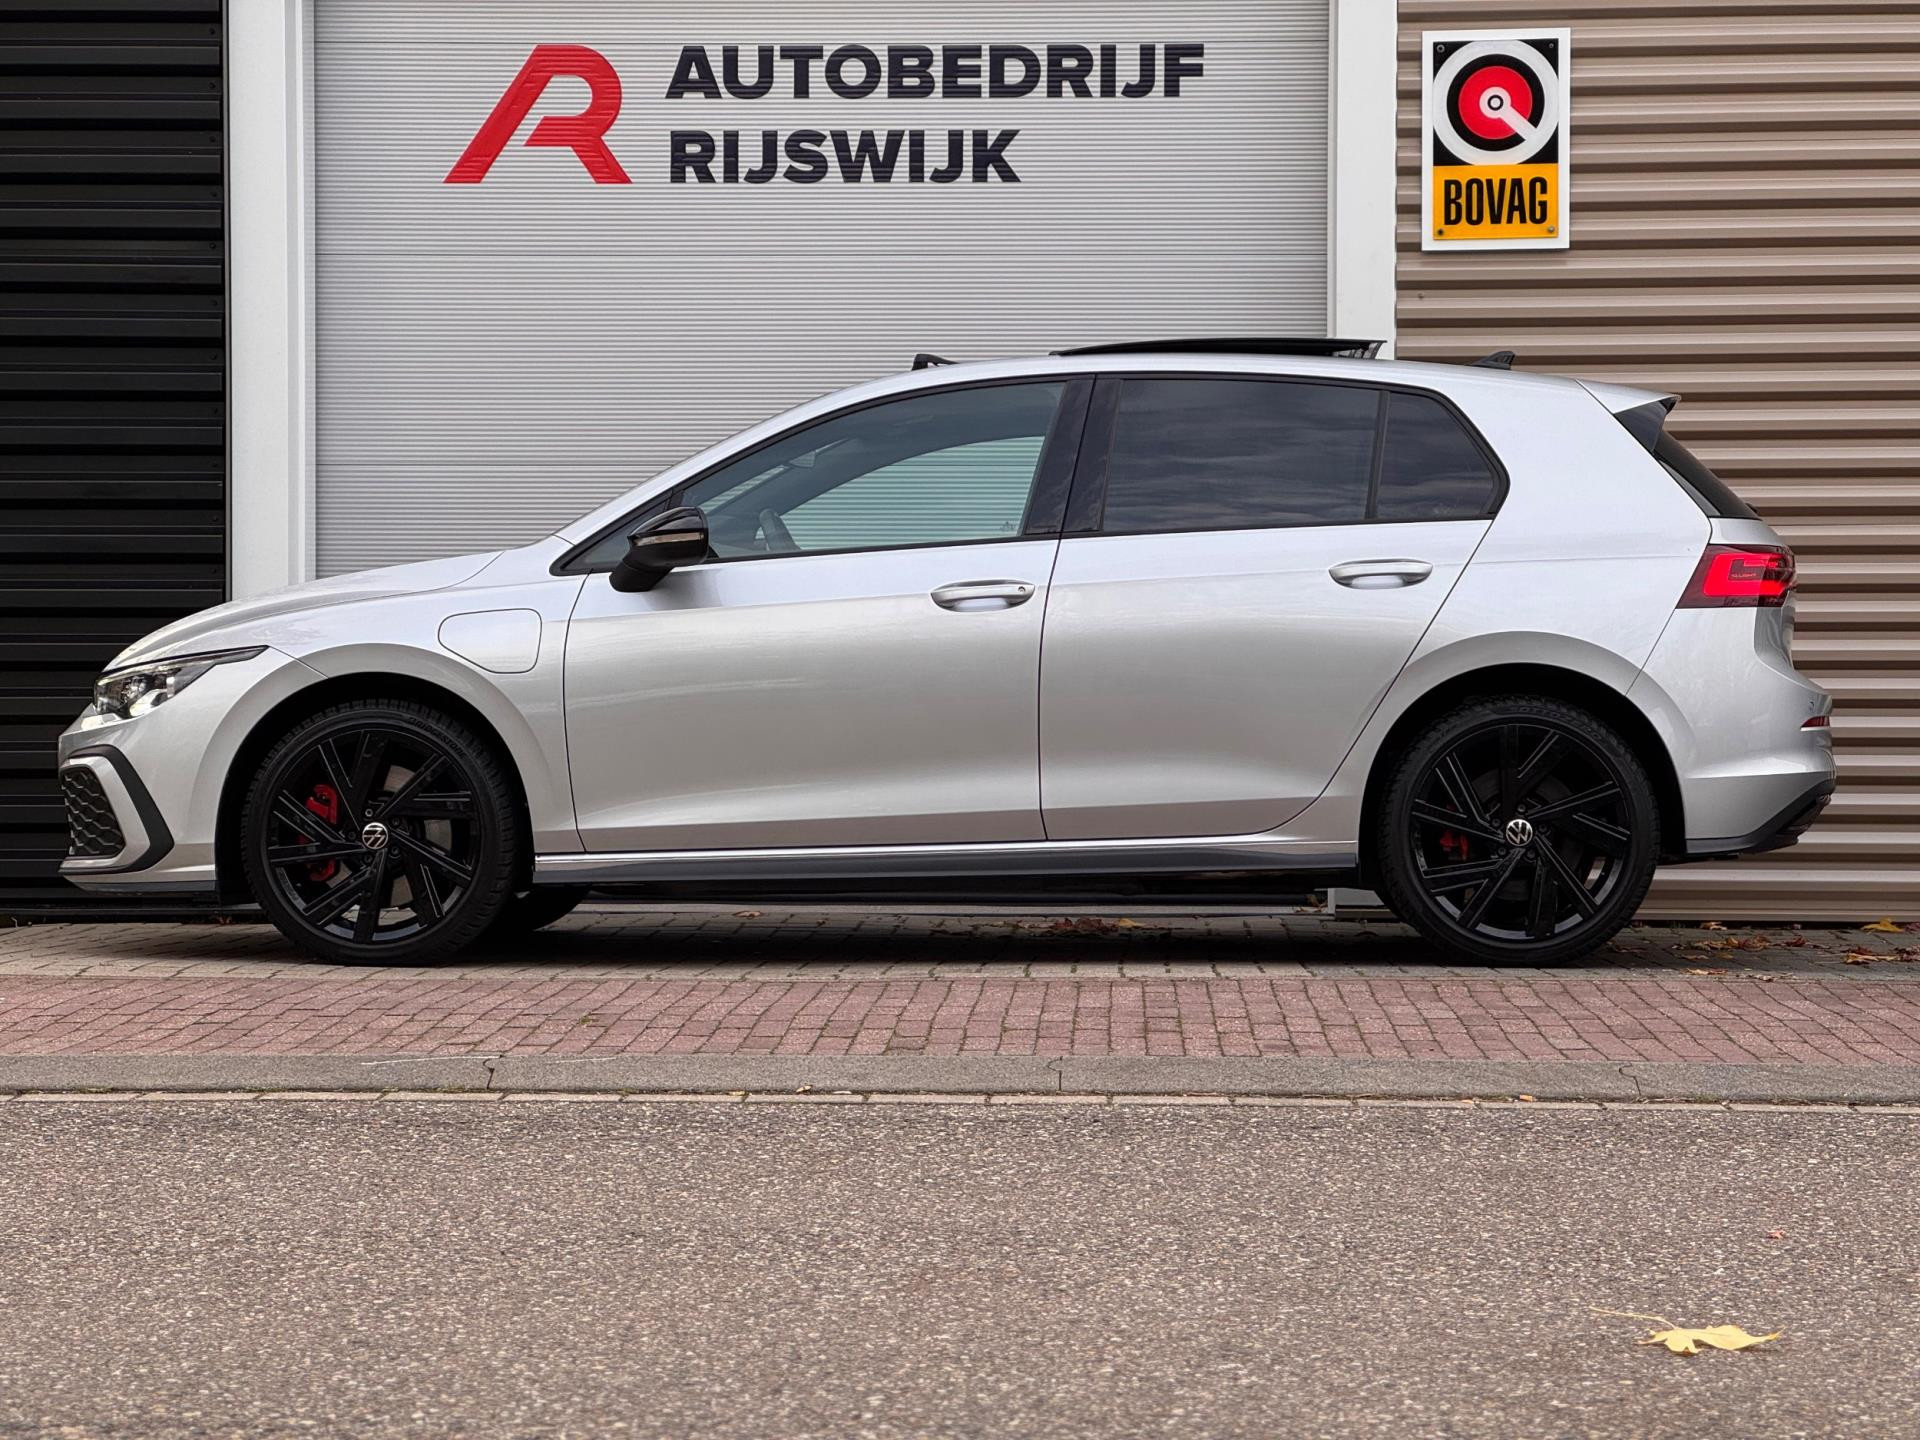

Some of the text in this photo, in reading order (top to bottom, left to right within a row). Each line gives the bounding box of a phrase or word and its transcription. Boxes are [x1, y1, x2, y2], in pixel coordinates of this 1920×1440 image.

[666, 44, 1205, 99] AUTOBEDRIJF
[671, 130, 1020, 184] RIJSWIJK
[1443, 177, 1548, 226] BOVAG
